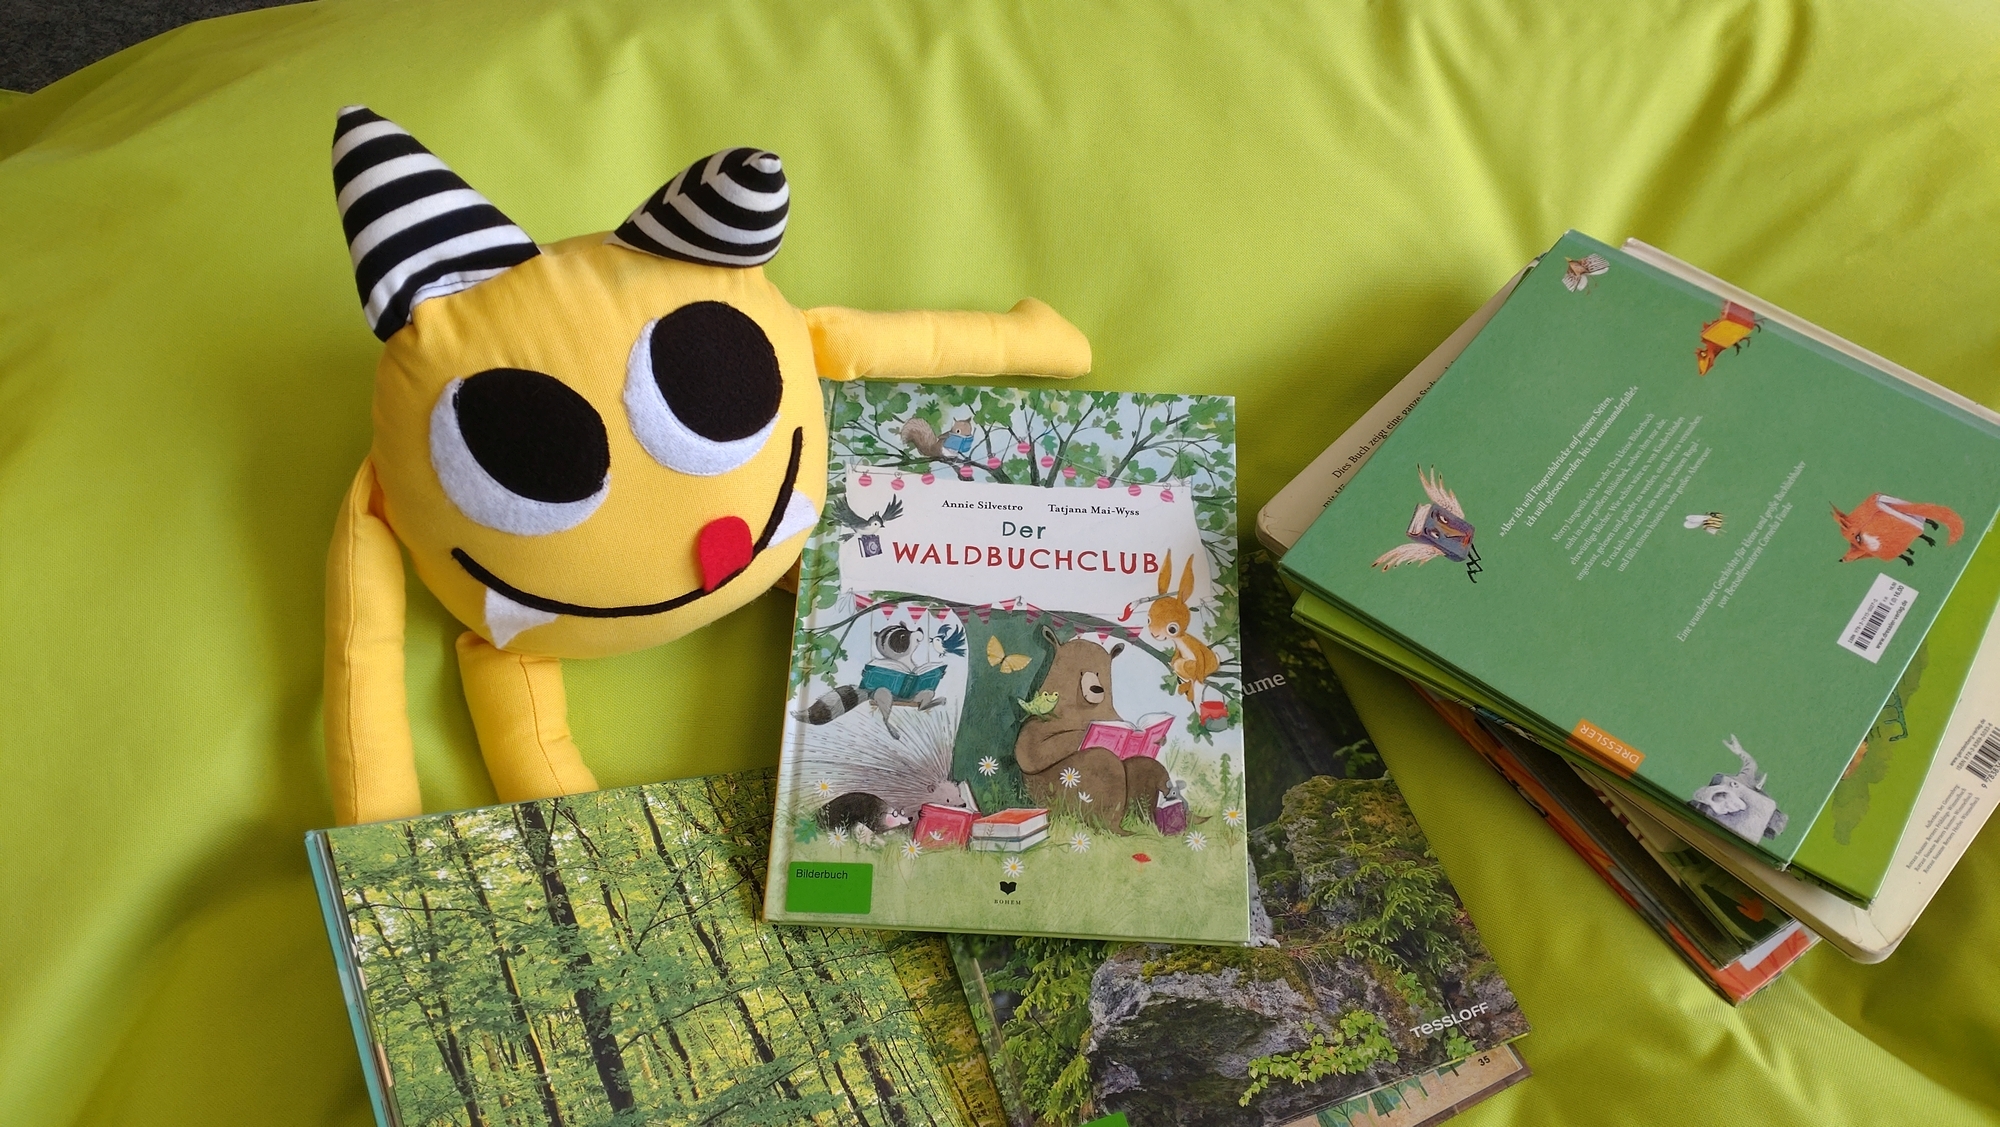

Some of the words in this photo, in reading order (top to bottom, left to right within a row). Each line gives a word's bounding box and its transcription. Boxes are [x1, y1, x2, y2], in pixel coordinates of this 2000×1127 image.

[1627, 410, 1654, 443] Bilderbuch
[1331, 459, 1351, 479] Dies
[1347, 442, 1370, 464] Buch
[1367, 427, 1389, 448] zeigt
[1385, 413, 1403, 431] eine
[1615, 439, 1633, 459] kleine
[1661, 447, 1676, 463] hier
[1672, 442, 1681, 451] zu
[1682, 439, 1700, 459] Regal
[1496, 515, 1517, 538] »Aber
[1511, 505, 1525, 518] ich
[1519, 491, 1536, 508] will
[1530, 445, 1574, 496] Fingerabdrücke
[1566, 434, 1582, 450] auf
[1575, 413, 1598, 438] meinen
[1592, 392, 1615, 418] Seiten,
[1607, 455, 1621, 469] Das
[1653, 459, 1667, 474] statt
[1668, 455, 1687, 477] seinem
[1523, 513, 1537, 527] ich
[1532, 500, 1547, 517] will
[1542, 478, 1567, 505] gelesen
[1559, 453, 1586, 483] werden,
[1578, 444, 1591, 458] bis
[1586, 435, 1599, 448] ich
[1597, 465, 1613, 482] sehr.
[1637, 470, 1660, 497] werden,
[1663, 473, 1674, 483] in
[1673, 472, 1693, 495] großes
[1562, 533, 1578, 551] steht
[1573, 527, 1583, 537] in
[1578, 512, 1594, 530] einer
[1589, 493, 1609, 516] großen
[1603, 464, 1632, 497] Bibliothek,
[1625, 448, 1643, 467] neben
[1638, 437, 1651, 451] ihm
[1648, 428, 1658, 440] nur
[1568, 530, 1599, 567] ehrwürdige
[1592, 509, 1613, 534] Bücher.
[1608, 498, 1622, 514] Wie
[1617, 481, 1634, 502] schön
[1629, 469, 1644, 486] wäre
[1640, 462, 1651, 473] es,
[1646, 453, 1657, 464] von
[1652, 413, 1685, 454] Kinderhänden
[1583, 485, 1598, 500] sich
[1594, 480, 1603, 489] so
[1651, 480, 1670, 501] wenig
[1634, 493, 1643, 502] zu
[1645, 496, 1656, 509] ein
[1660, 502, 1670, 512] in
[1664, 490, 1679, 505] sein
[941, 500, 975, 510] Annie
[977, 501, 1024, 512] Silvestro
[1047, 503, 1088, 515] Tatjana
[1090, 505, 1141, 518] Mai-Wyss
[1565, 497, 1590, 526] langweilt
[1618, 499, 1639, 522] geliebt
[1630, 505, 1650, 528] zuckelt
[1646, 508, 1665, 530] hinein
[1002, 521, 1047, 540] Der
[1551, 522, 1571, 544] Morry
[1609, 518, 1623, 533] und
[1621, 525, 1635, 540] und
[1594, 529, 1616, 555] gelesen
[1633, 526, 1652, 548] mitten
[892, 541, 1160, 575] WALDBUCHCLUB
[1607, 537, 1627, 560] ruckelt
[1624, 545, 1639, 561] fällt
[1676, 624, 1692, 642] Eine
[1686, 587, 1718, 627] wunderbare
[1711, 555, 1740, 591] Geschichte
[1733, 544, 1749, 560] für
[1741, 527, 1759, 548] kleine
[1753, 515, 1768, 531] und
[1761, 498, 1781, 520] große
[1773, 458, 1807, 502] Buchliebhaber
[1717, 594, 1730, 608] von
[1724, 544, 1764, 596] Bestsellerautorin
[1757, 519, 1781, 548] Cornelia
[1775, 500, 1794, 522] Funke
[1574, 550, 1601, 582] angefasst,
[1601, 557, 1612, 568] Er
[1616, 557, 1630, 572] und
[1874, 599, 1909, 649] www.dressler-verlag.de
[1847, 633, 1856, 643] ISBN
[1241, 673, 1286, 697] ume
[1578, 723, 1639, 764] DRESSLER
[1955, 759, 1966, 771] ISBN
[795, 868, 848, 880] Bilderbuch
[1477, 1055, 1491, 1067] 35
